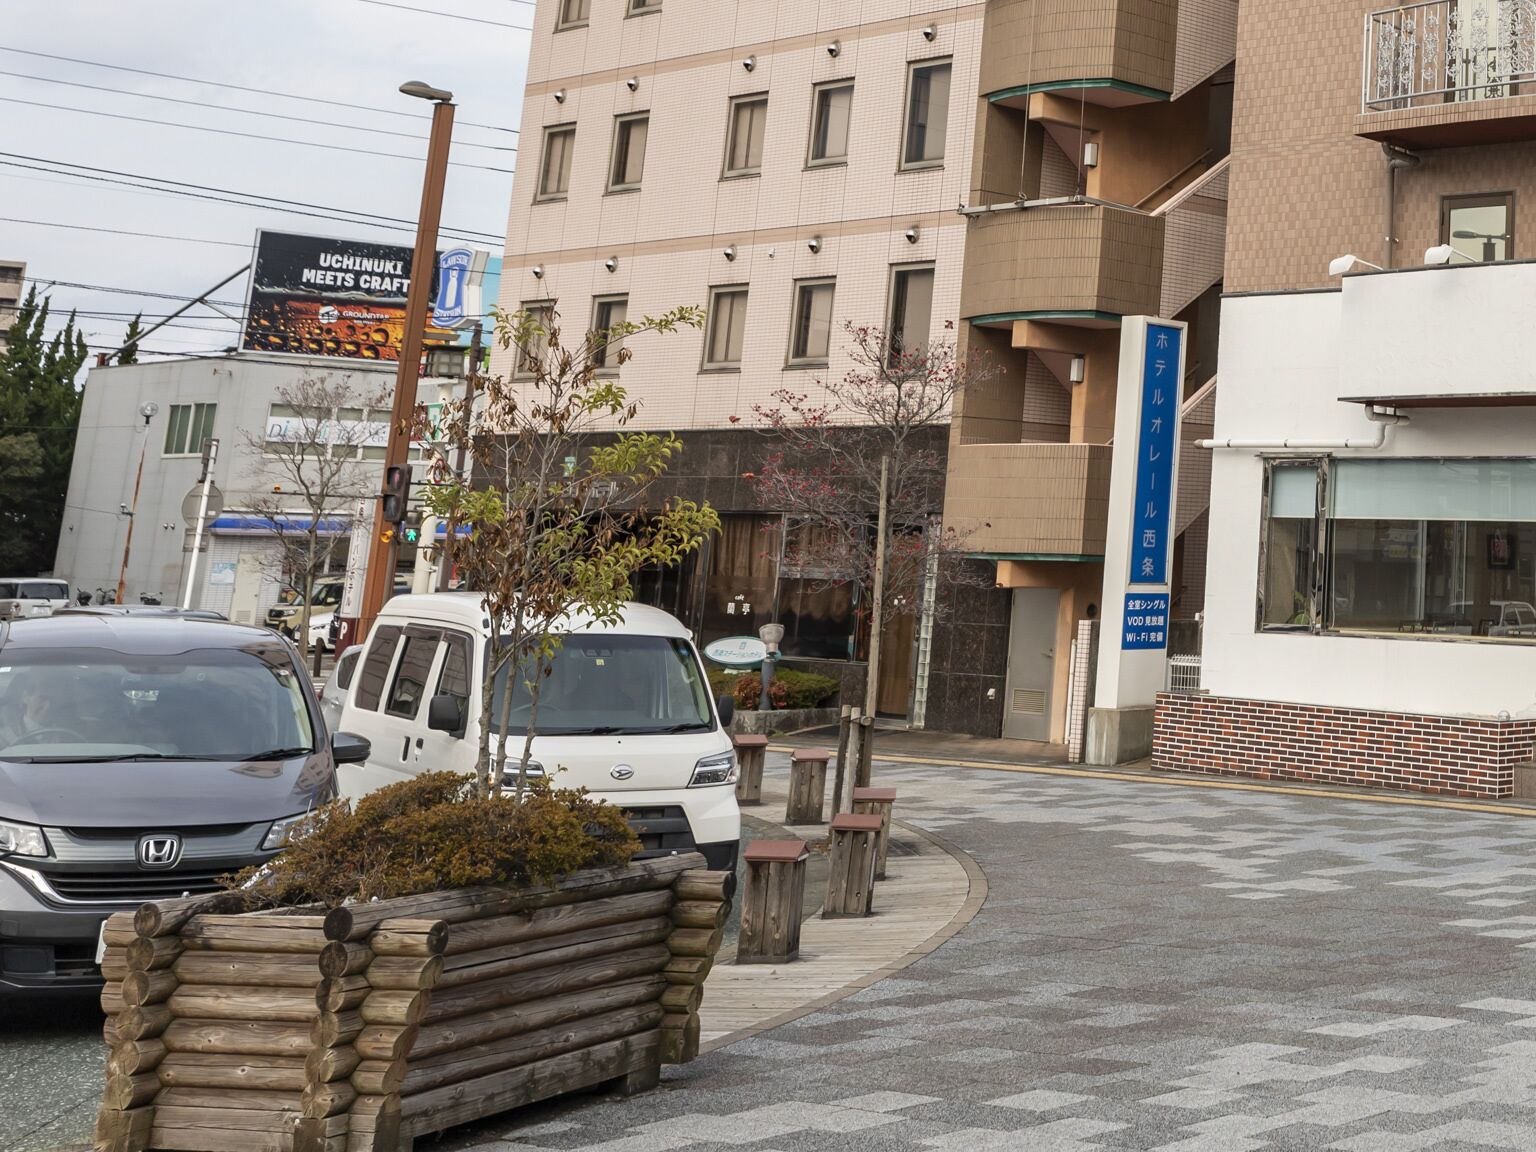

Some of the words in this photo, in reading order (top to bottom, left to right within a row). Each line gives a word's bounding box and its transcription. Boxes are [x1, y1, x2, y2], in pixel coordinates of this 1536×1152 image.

[319, 252, 404, 275] UCHINUKI
[442, 254, 470, 268] LAWSON
[301, 268, 356, 288] MEETS
[359, 275, 411, 294] CRAFT
[1141, 332, 1169, 577] ホテルオレール西条
[1127, 599, 1166, 610] 全室シングル
[1127, 616, 1143, 626] VOD
[339, 621, 348, 640] P
[1126, 632, 1148, 642] Wi-Fi
